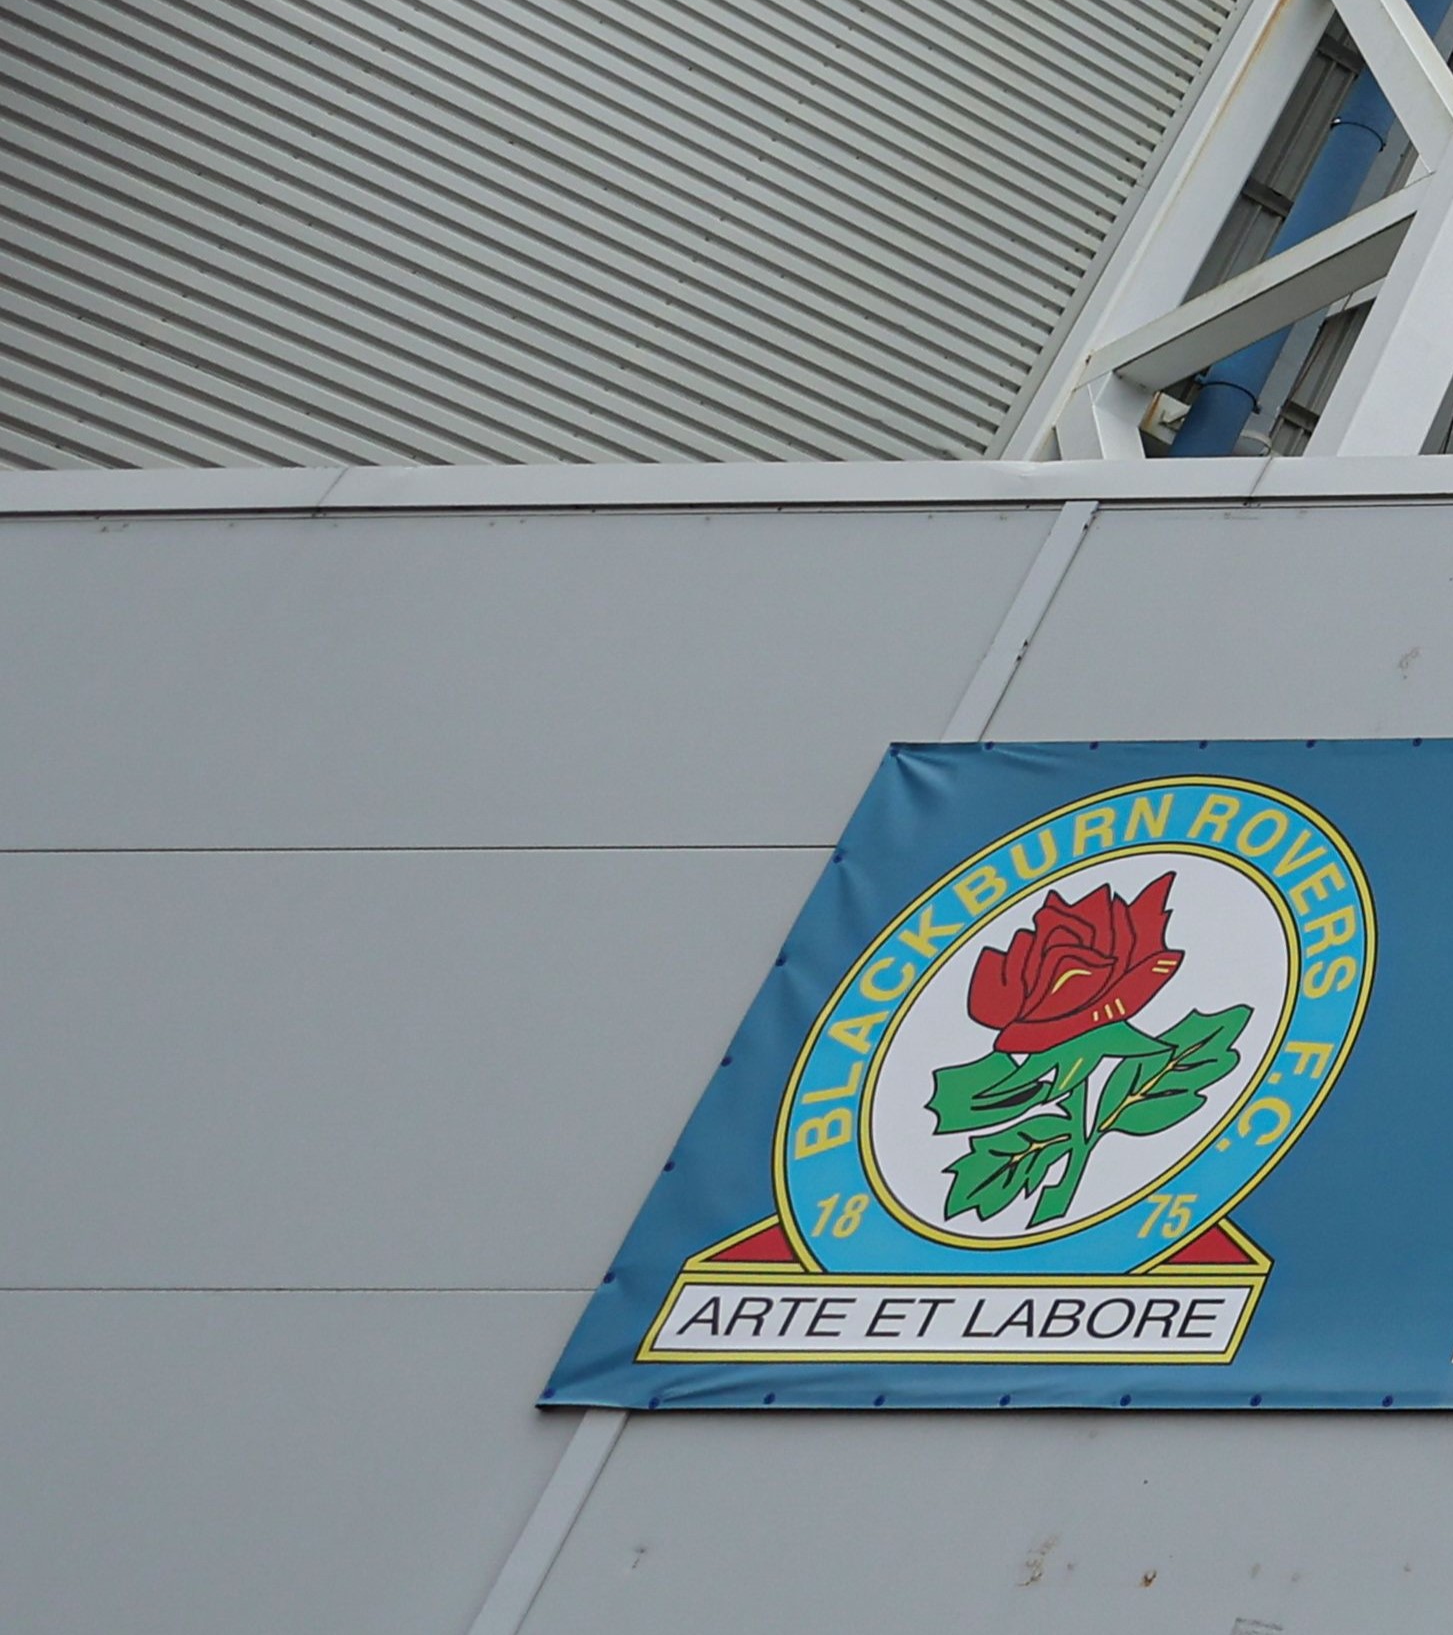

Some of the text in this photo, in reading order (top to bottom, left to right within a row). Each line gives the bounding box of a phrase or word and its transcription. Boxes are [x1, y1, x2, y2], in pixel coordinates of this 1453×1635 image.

[796, 794, 1356, 1159] BLACKBURN ROVERS F.C.
[811, 1194, 1196, 1238] 18 75
[676, 1297, 1225, 1339] ARTE ET LABORE
